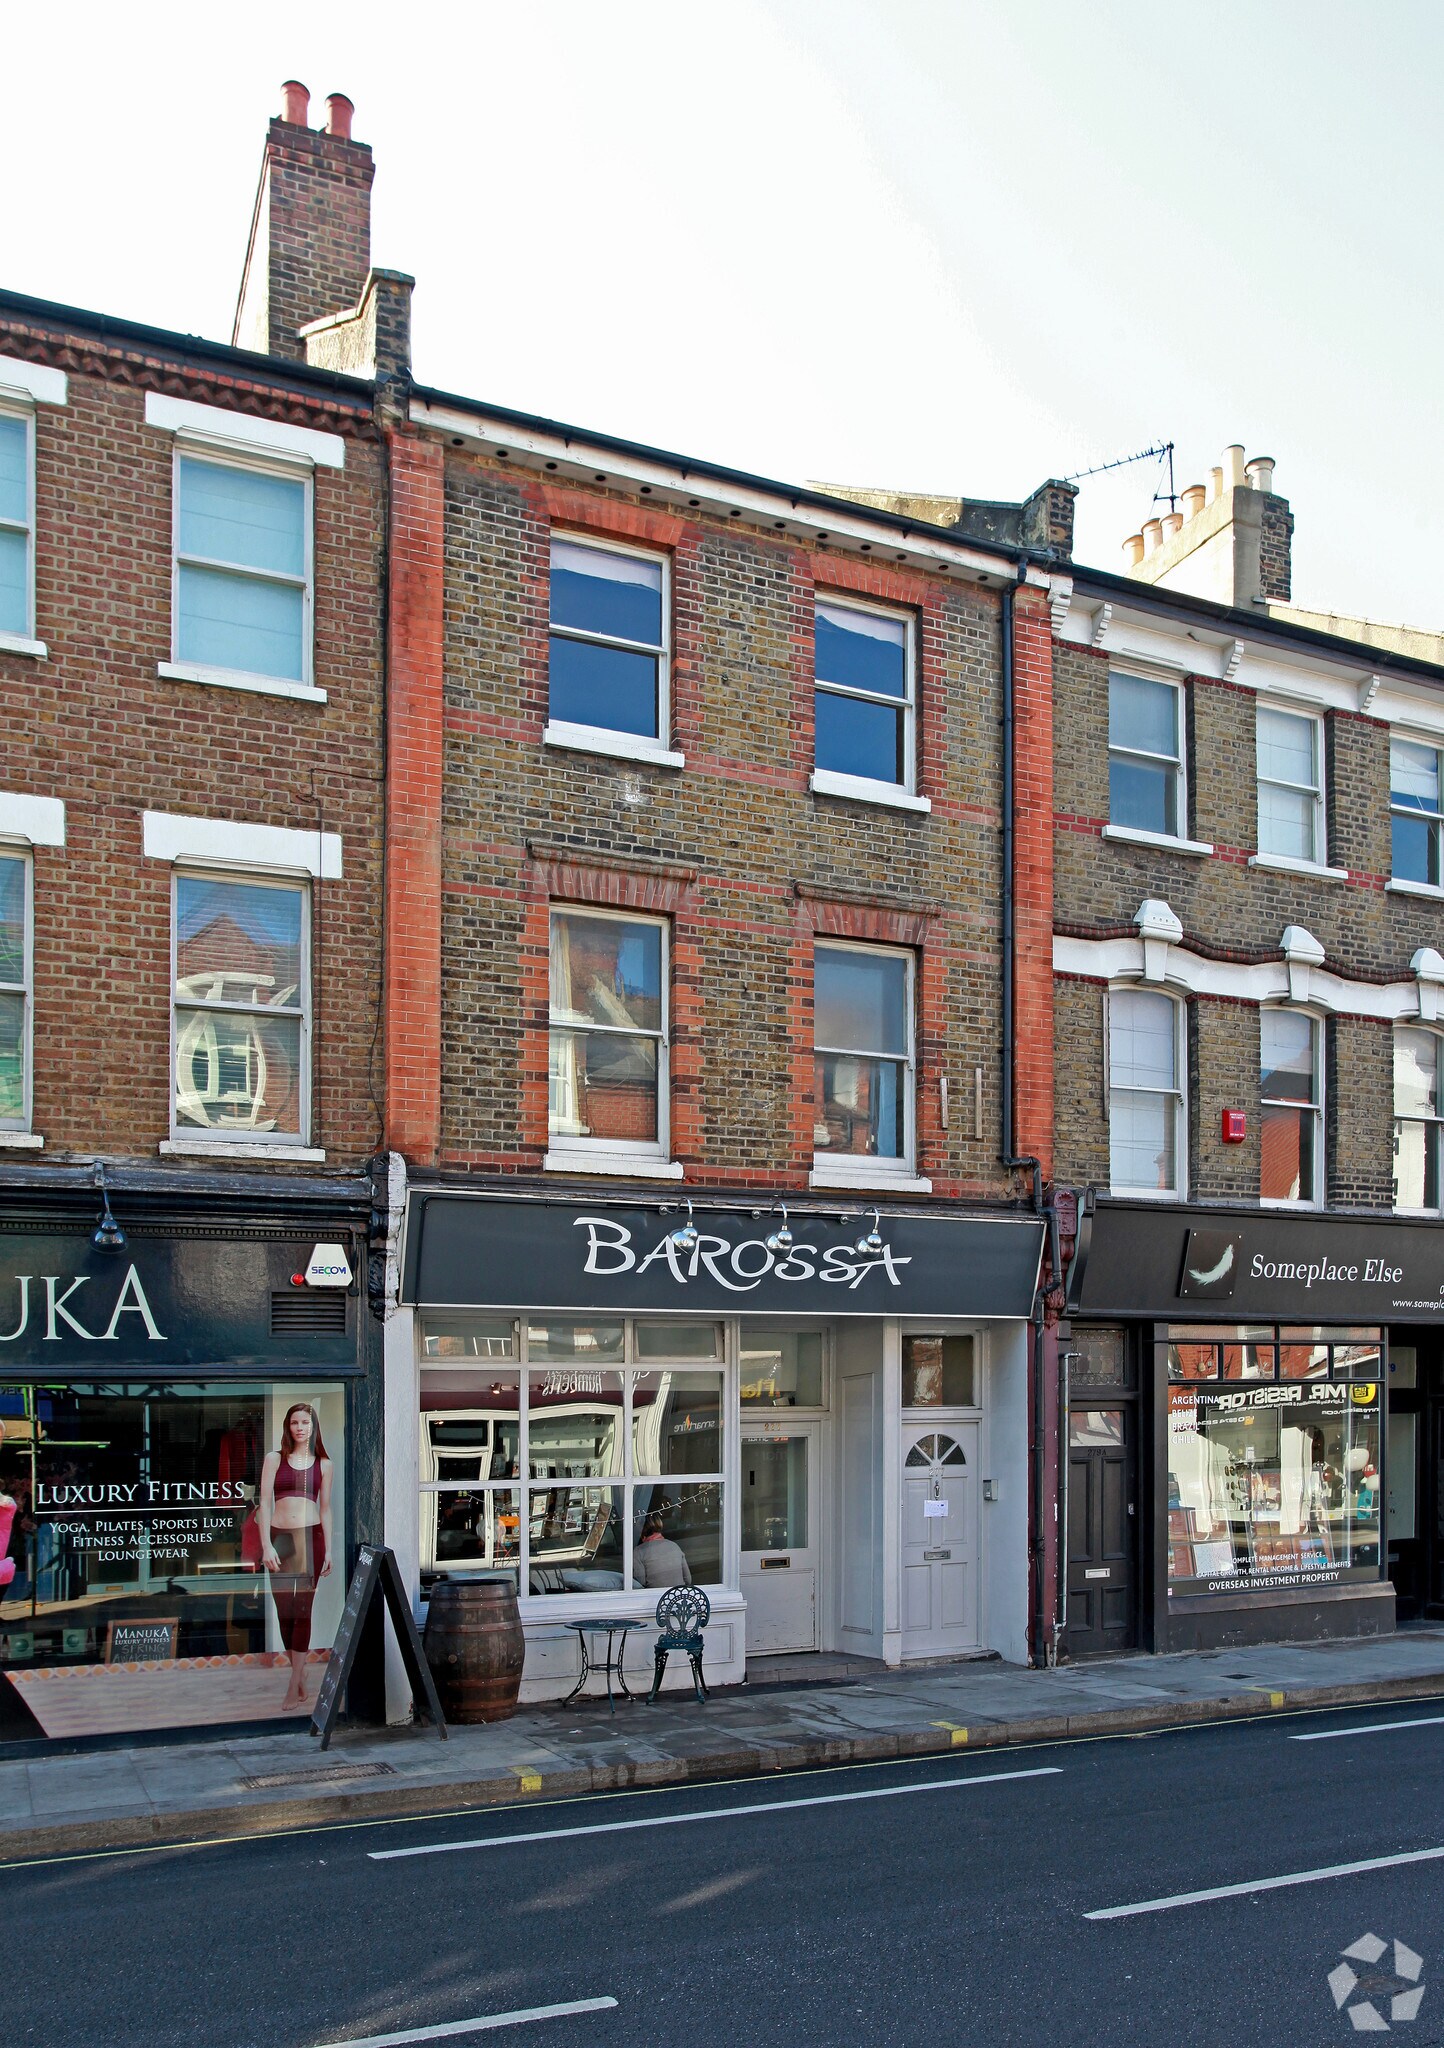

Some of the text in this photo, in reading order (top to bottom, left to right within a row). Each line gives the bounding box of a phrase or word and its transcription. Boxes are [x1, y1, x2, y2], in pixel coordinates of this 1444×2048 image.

[572, 1216, 912, 1291] BAROSSA
[311, 1265, 347, 1275] SECOM
[1250, 1253, 1403, 1288] Someplace Else
[1171, 1395, 1219, 1405] ARGENTINA
[1171, 1408, 1198, 1418] BELIZE
[1172, 1422, 1200, 1431] BRAZIL
[1171, 1435, 1196, 1445] CHILE
[37, 1480, 245, 1504] LUXURY FITNESS
[152, 1518, 198, 1530] SPORTS
[203, 1517, 233, 1528] LUXE
[72, 1533, 213, 1548] FITNESS ACCESSORIES
[98, 1549, 190, 1562] LOUNGEWEAR
[1258, 1553, 1299, 1563] MANAGEMENT
[1195, 1571, 1220, 1579] CAPITAL
[1249, 1567, 1270, 1576] RENTAL
[1270, 1565, 1294, 1573] INCOME
[1300, 1563, 1326, 1571] LIFESTYLE
[1327, 1560, 1352, 1569] BENEFITS
[1208, 1571, 1340, 1591] OVERSEAS INVESTMENT PROPERTY
[115, 1626, 169, 1640] MANUKA
[114, 1637, 170, 1646] LUXURY FITNESS
